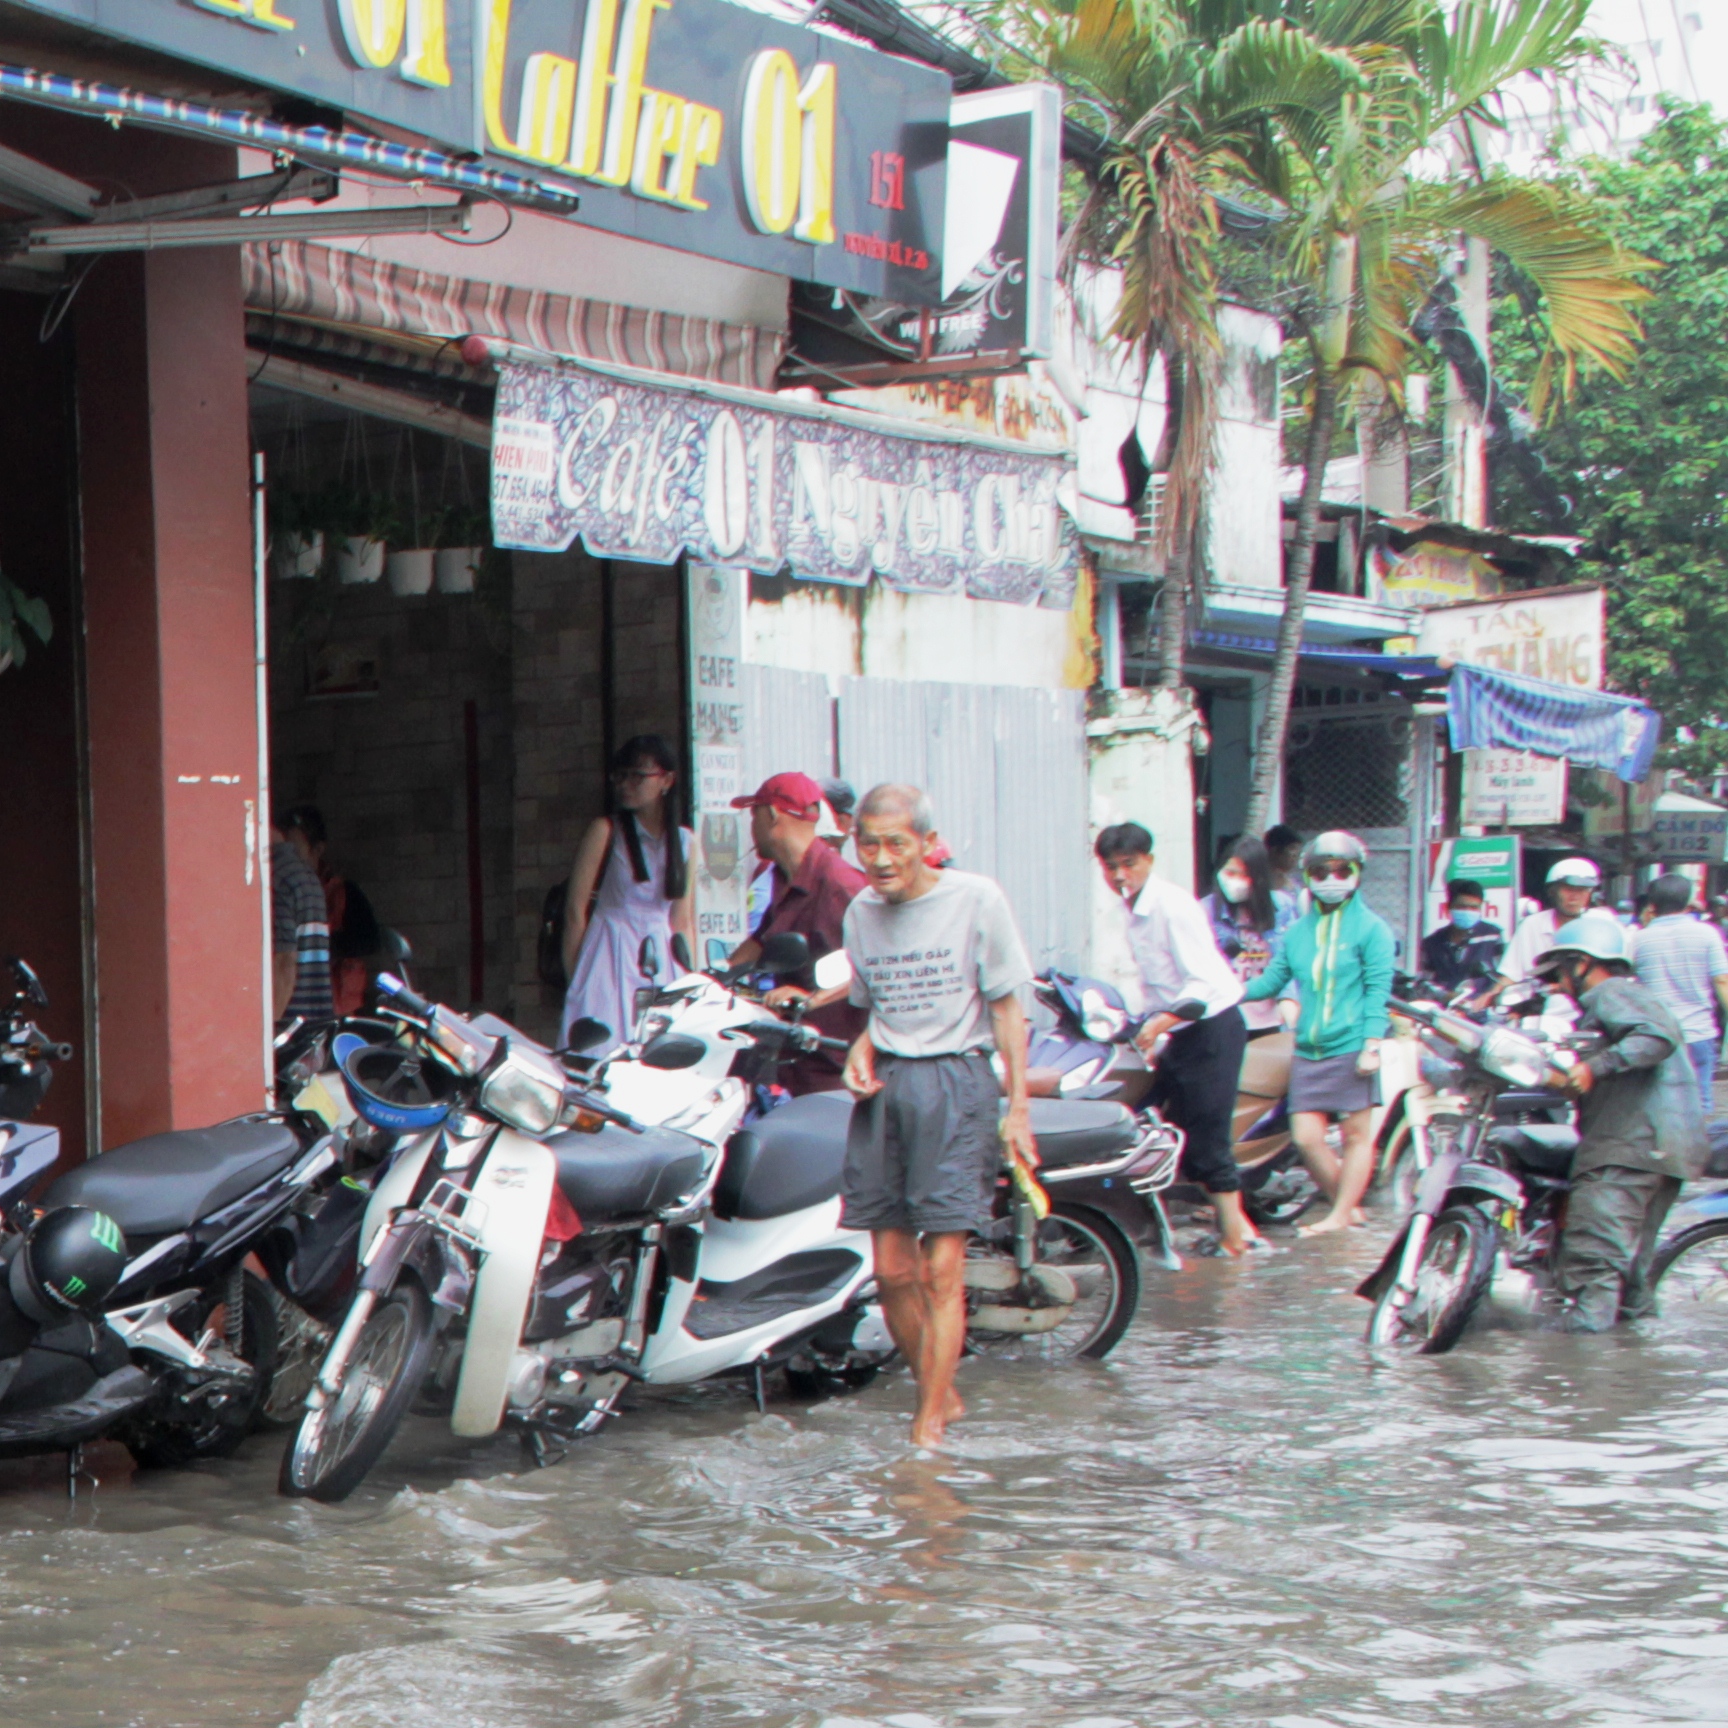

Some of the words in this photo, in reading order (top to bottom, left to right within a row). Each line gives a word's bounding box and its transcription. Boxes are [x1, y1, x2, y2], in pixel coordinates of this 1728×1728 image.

[742, 48, 836, 244] 01
[900, 317, 937, 341] WII
[939, 313, 983, 335] FREE
[558, 396, 699, 548] Café
[704, 410, 776, 559] 01
[788, 441, 964, 573] Nguyên
